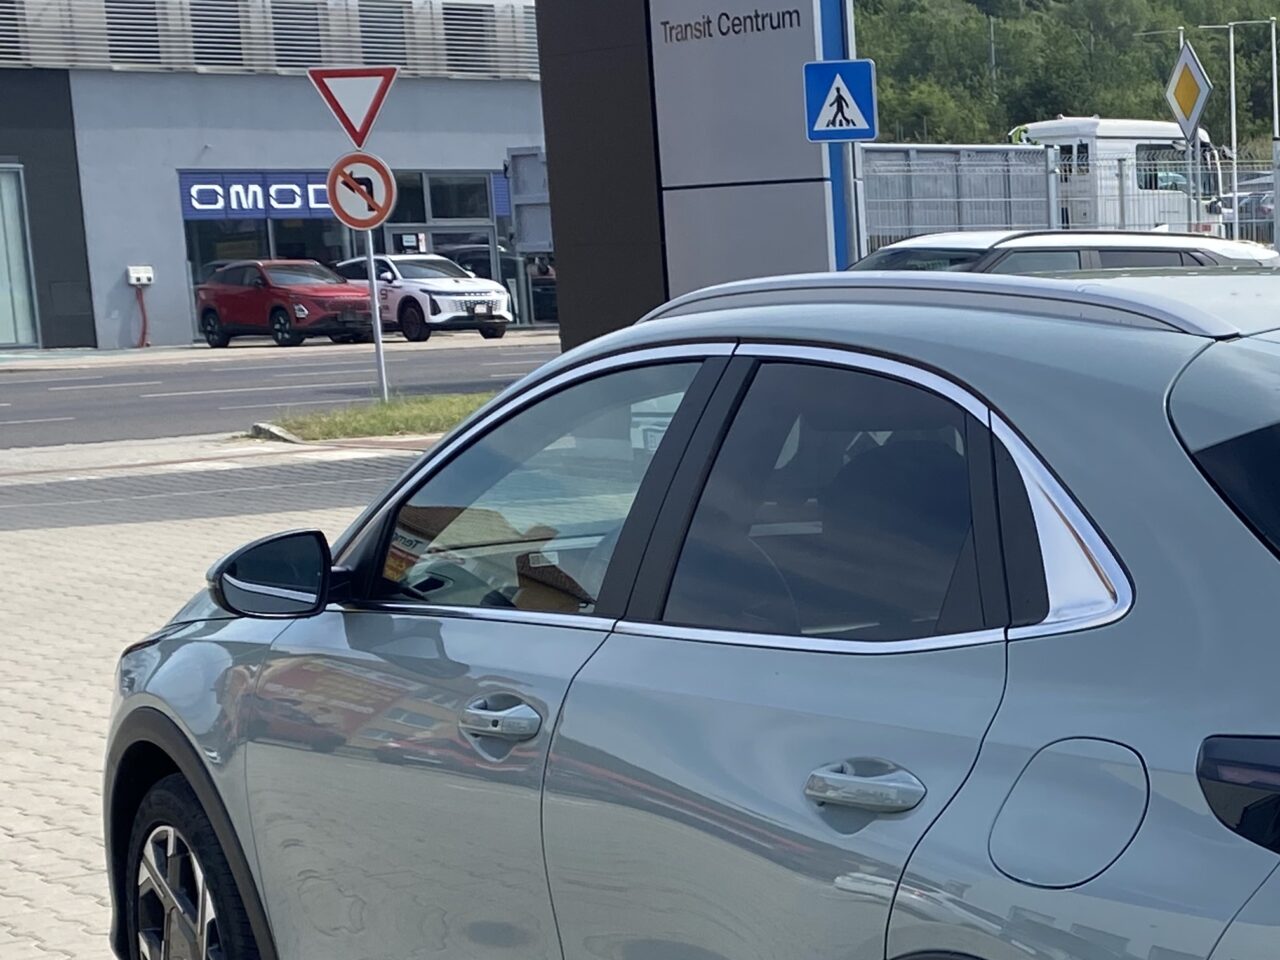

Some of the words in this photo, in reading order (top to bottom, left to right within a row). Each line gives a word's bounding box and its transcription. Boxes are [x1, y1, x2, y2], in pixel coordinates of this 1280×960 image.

[661, 15, 713, 43] Transit
[717, 9, 801, 36] Centrum
[190, 184, 331, 210] OMOD
